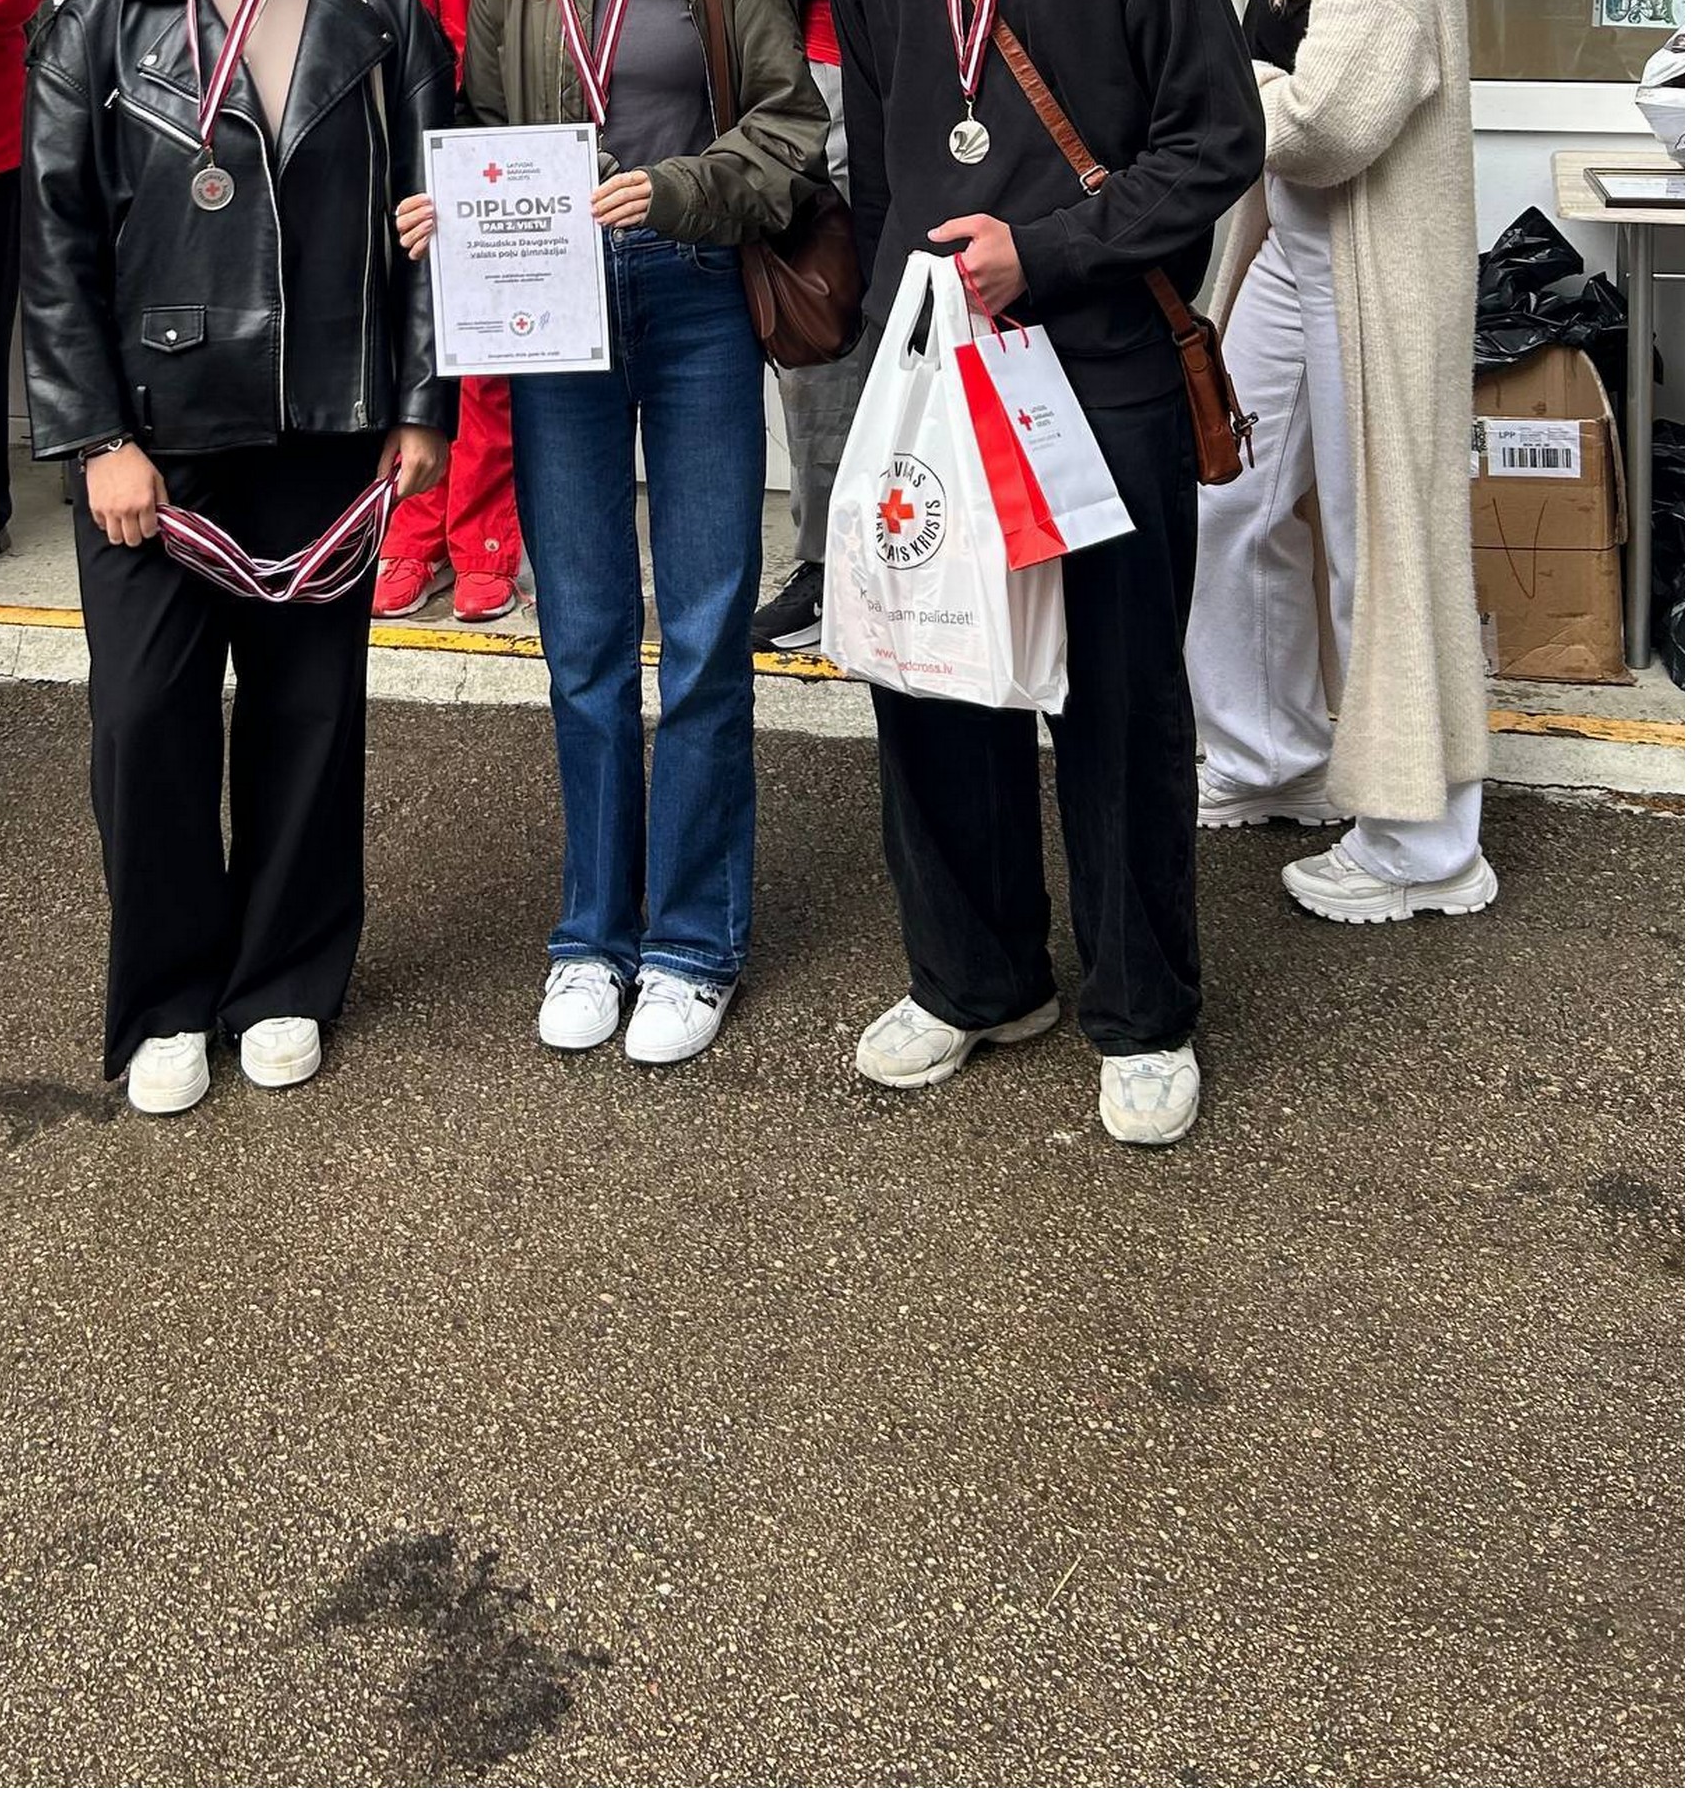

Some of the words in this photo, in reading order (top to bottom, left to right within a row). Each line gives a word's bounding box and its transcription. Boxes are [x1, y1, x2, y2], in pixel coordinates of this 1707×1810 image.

[457, 196, 573, 219] DIPLOMS
[483, 222, 505, 231] PAR
[516, 220, 547, 230] VIETU
[518, 236, 569, 247] Daugavpils
[909, 499, 942, 557] KRUSTS
